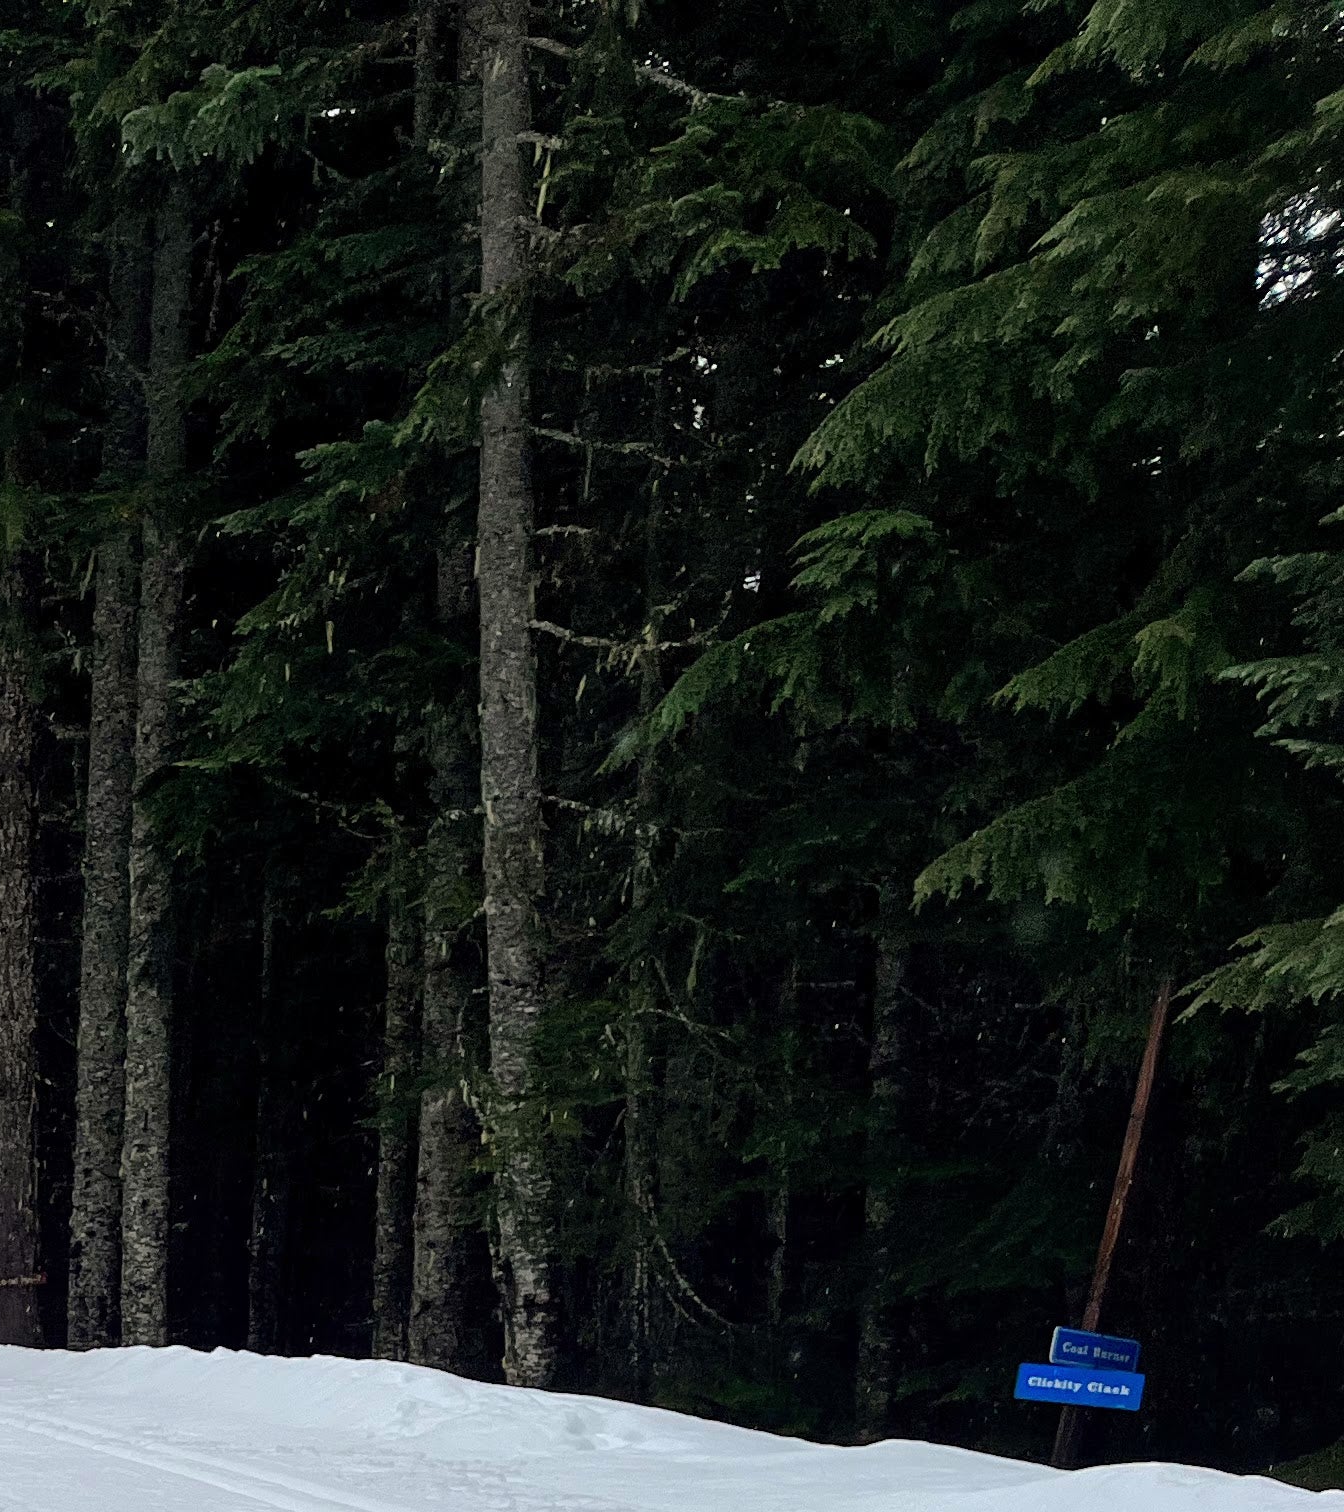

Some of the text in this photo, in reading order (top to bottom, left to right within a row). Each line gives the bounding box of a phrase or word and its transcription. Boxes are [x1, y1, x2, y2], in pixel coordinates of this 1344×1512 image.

[1062, 1341, 1088, 1355] Coal
[1028, 1376, 1131, 1396] Clickity Clack
